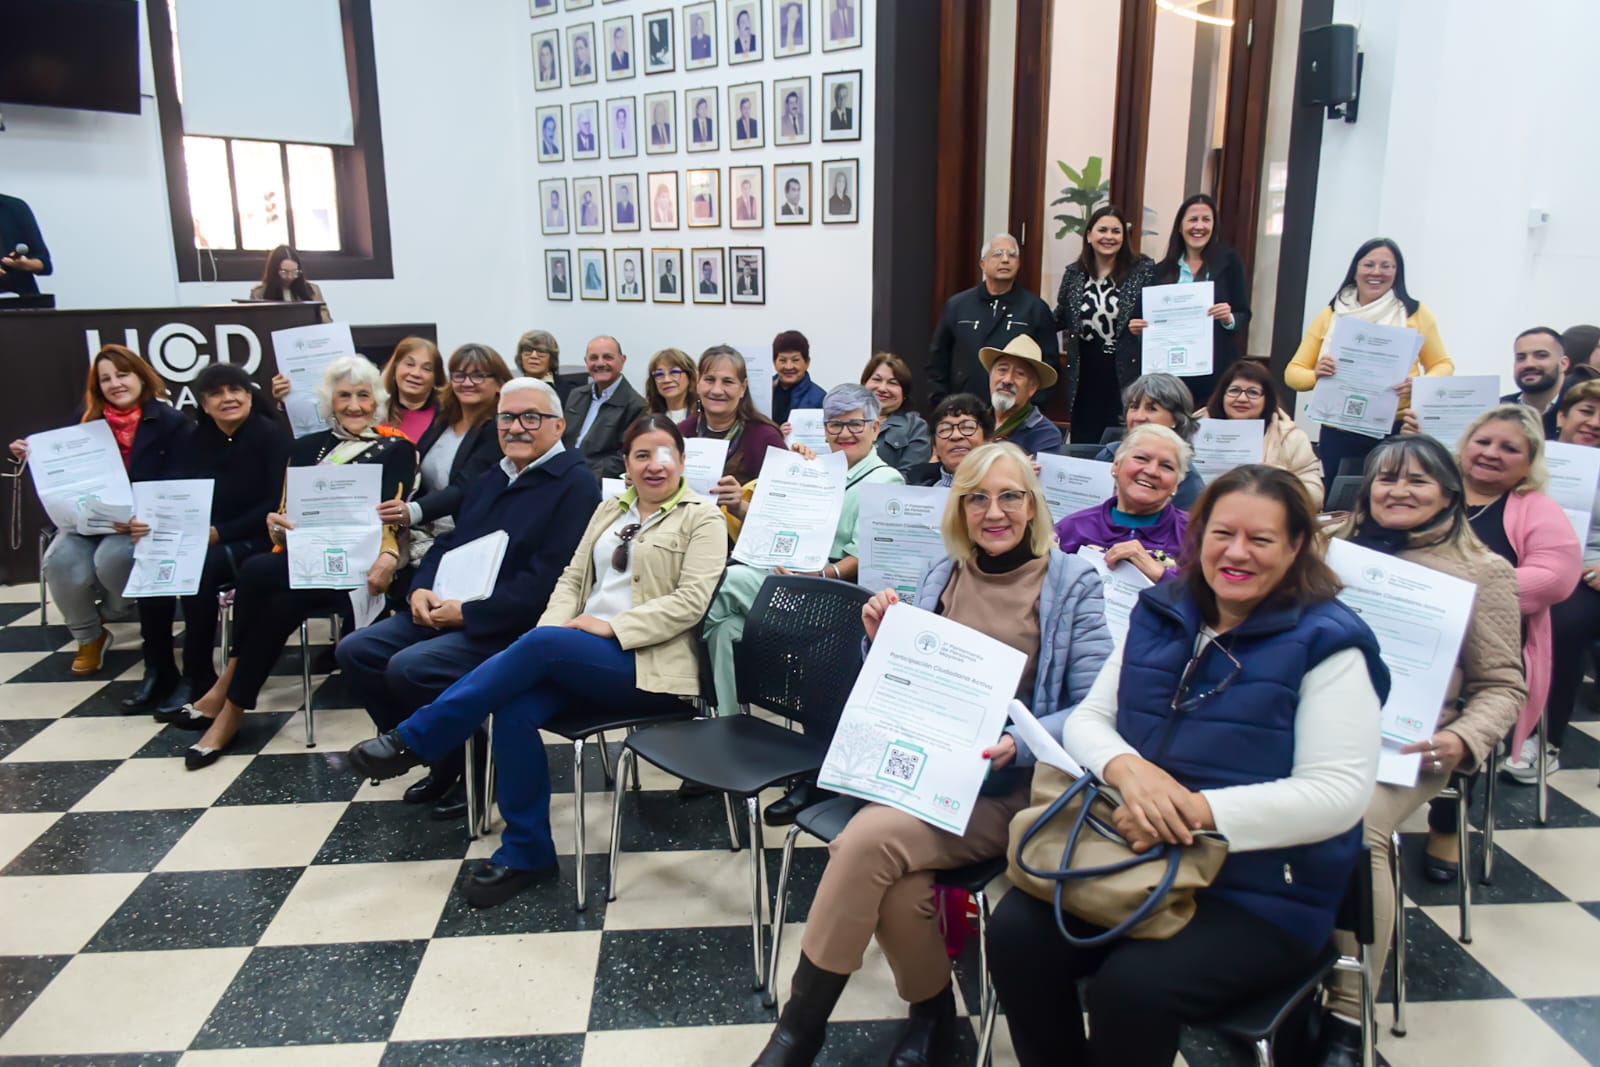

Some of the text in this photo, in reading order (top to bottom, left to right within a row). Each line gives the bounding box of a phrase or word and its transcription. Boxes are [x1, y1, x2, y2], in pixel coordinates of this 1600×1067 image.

[889, 652, 932, 669] Participación
[933, 665, 971, 681] Ciudadana
[972, 678, 993, 690] Activa
[932, 793, 961, 810] HCD
